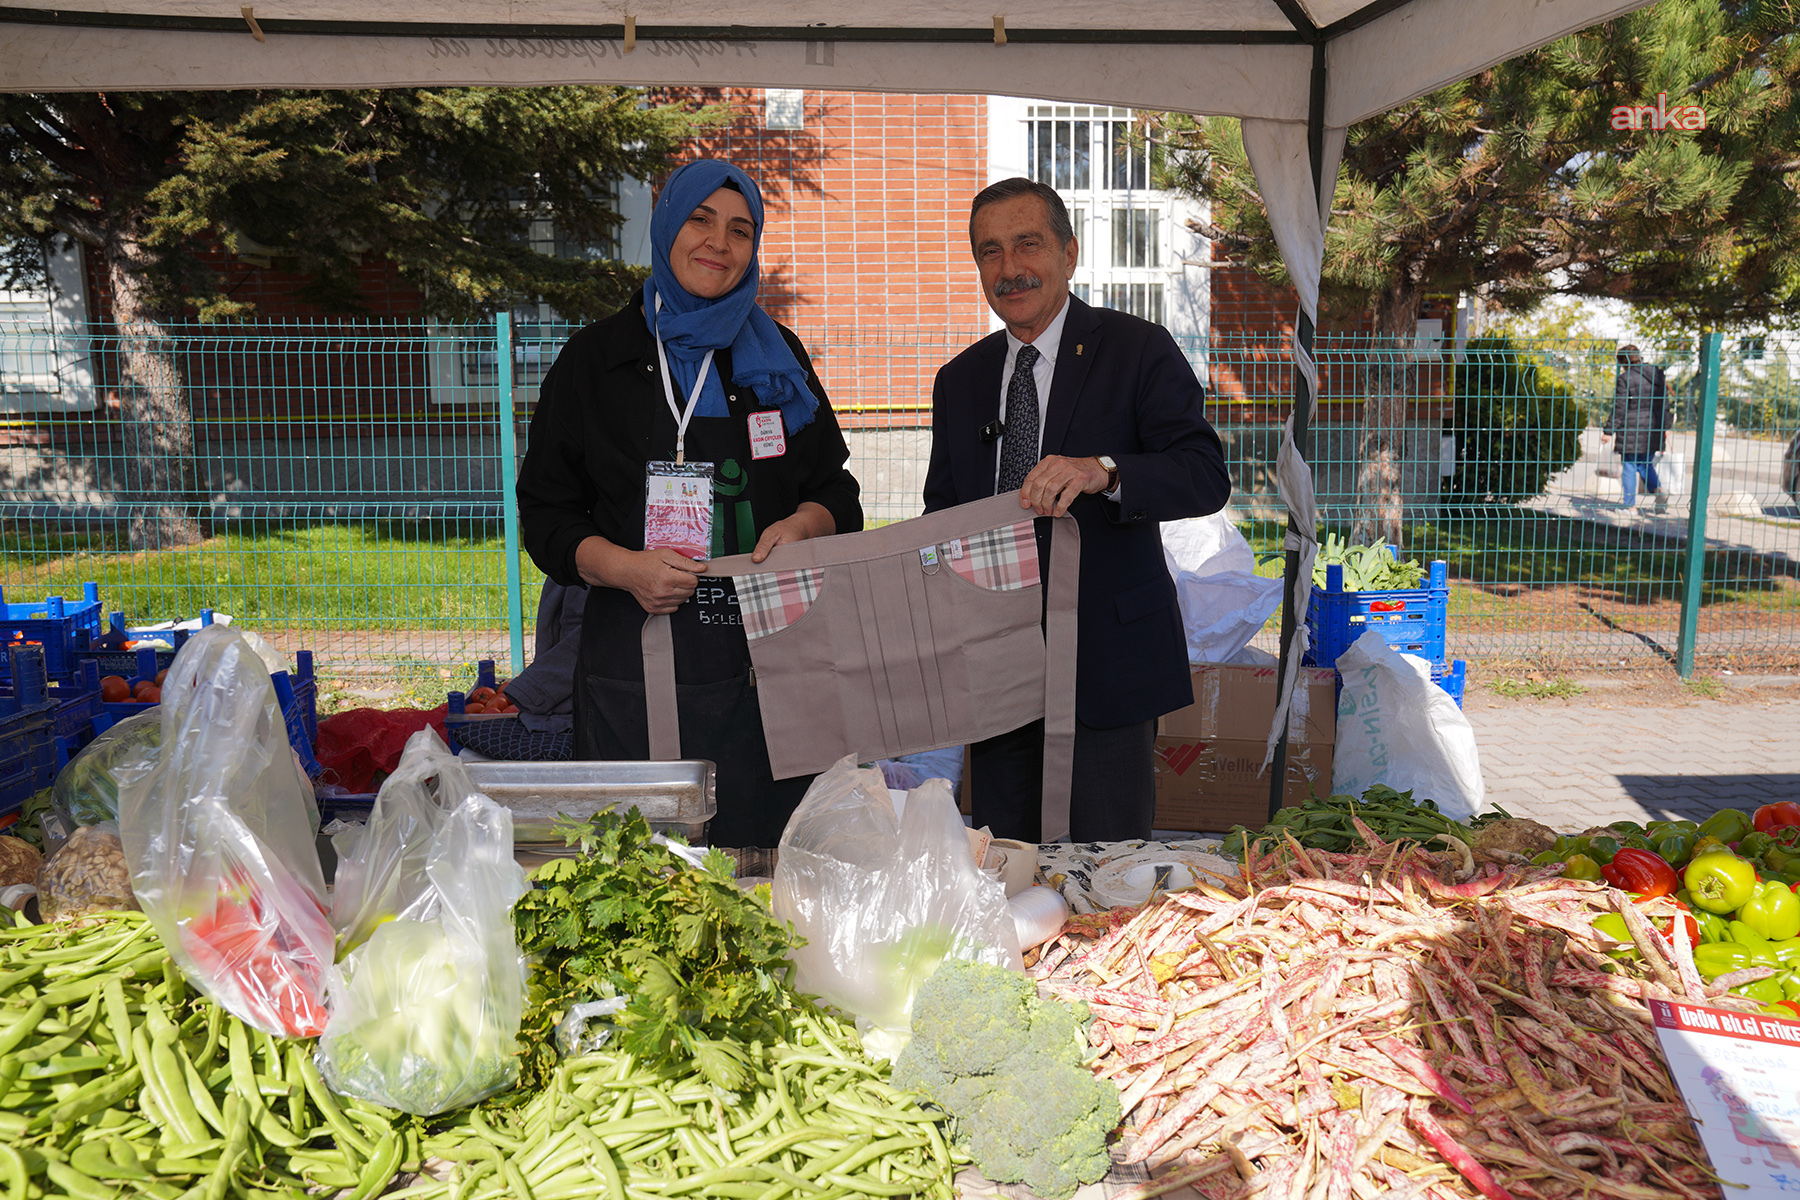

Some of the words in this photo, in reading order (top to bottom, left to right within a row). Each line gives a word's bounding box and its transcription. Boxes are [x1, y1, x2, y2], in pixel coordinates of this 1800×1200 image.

[1678, 1006, 1720, 1031] ÜRÜN
[1720, 1013, 1761, 1037] BİLGİ
[1760, 1020, 1800, 1043] ETİKE
